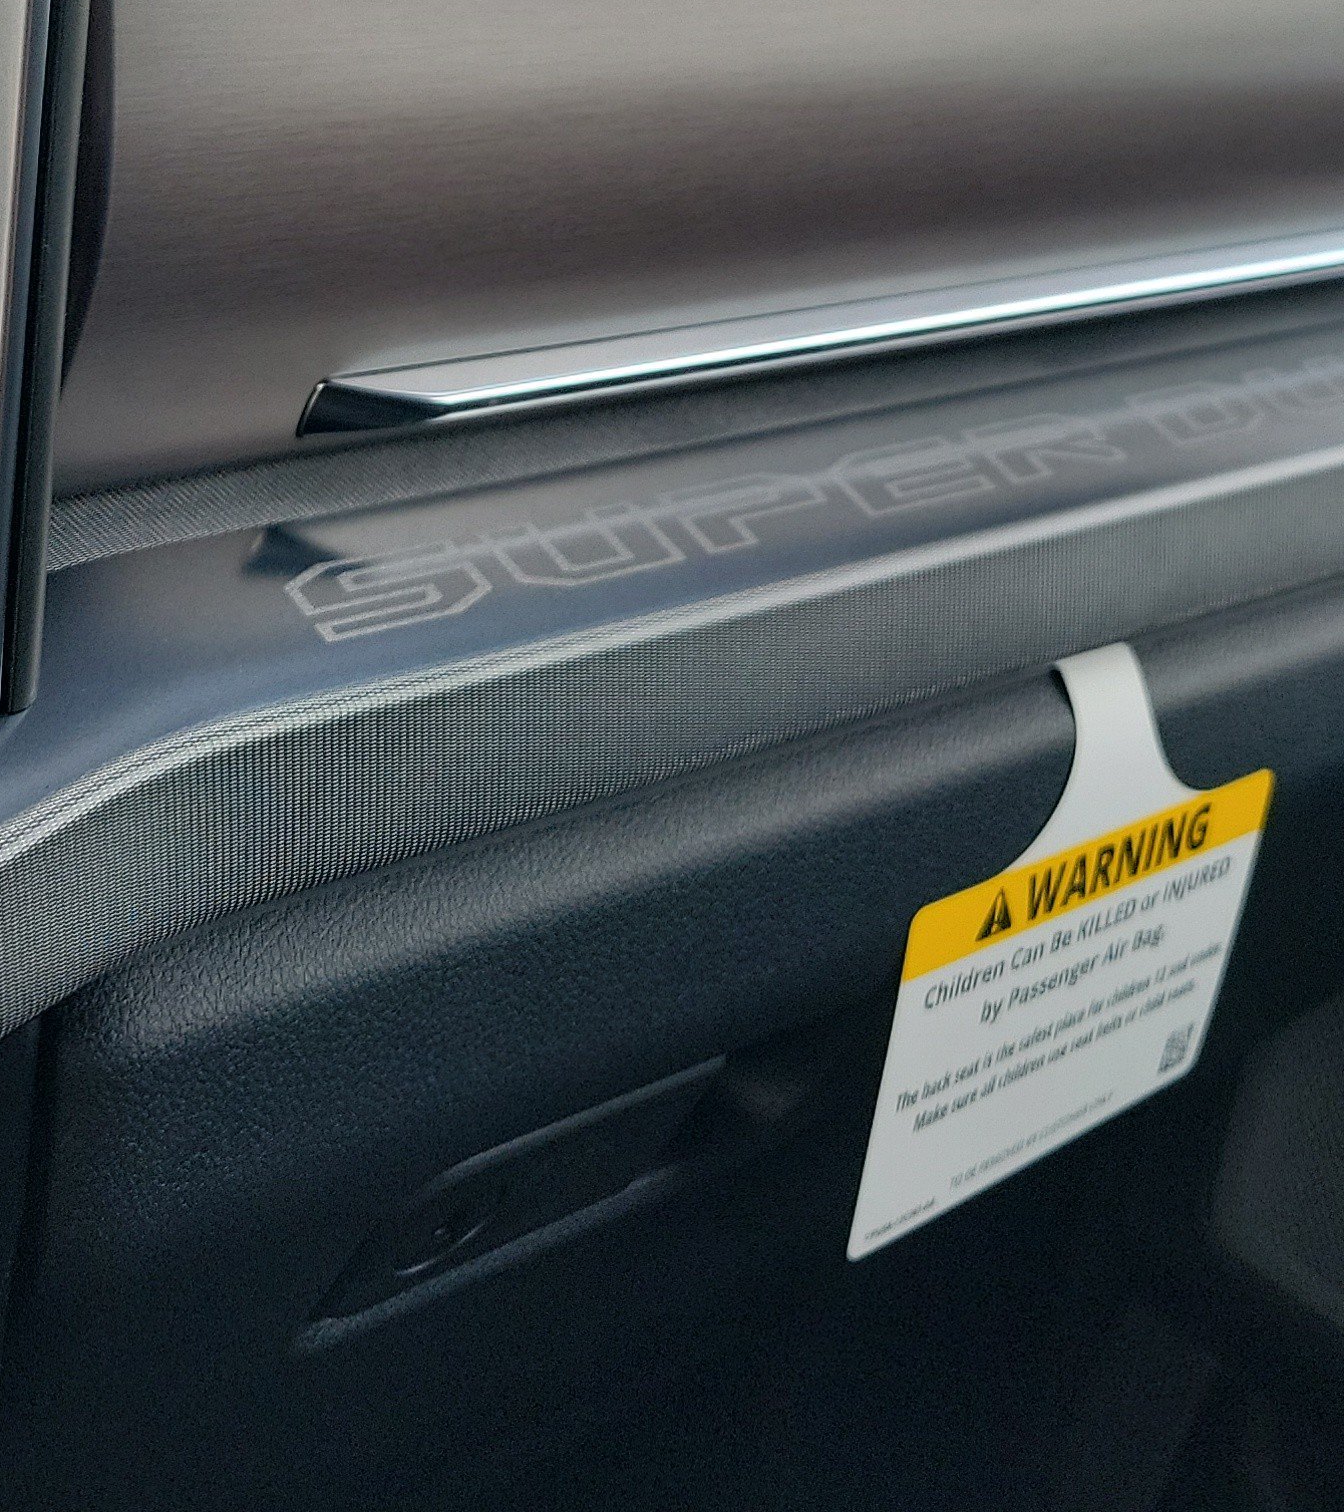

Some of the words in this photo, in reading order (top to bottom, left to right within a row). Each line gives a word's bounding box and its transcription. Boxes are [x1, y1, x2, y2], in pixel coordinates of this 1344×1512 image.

[282, 420, 1126, 644] SUPER
[1026, 802, 1213, 921] WARNING
[924, 958, 1006, 1009] Children
[1011, 940, 1045, 971] Can
[1050, 928, 1073, 953] Be
[1076, 898, 1137, 942] KILLED
[1141, 890, 1160, 912] or
[1163, 855, 1232, 903] INJURED
[980, 998, 1004, 1024] by
[1007, 954, 1100, 1011] Passenger
[1102, 940, 1128, 966] Air
[895, 1089, 920, 1114] The
[921, 1070, 952, 1100] back
[954, 1058, 980, 1084] seat
[982, 1049, 994, 1071] is
[995, 1041, 1016, 1063] the
[912, 1102, 949, 1134] Make
[951, 1088, 978, 1113] sure
[979, 1074, 998, 1099] all
